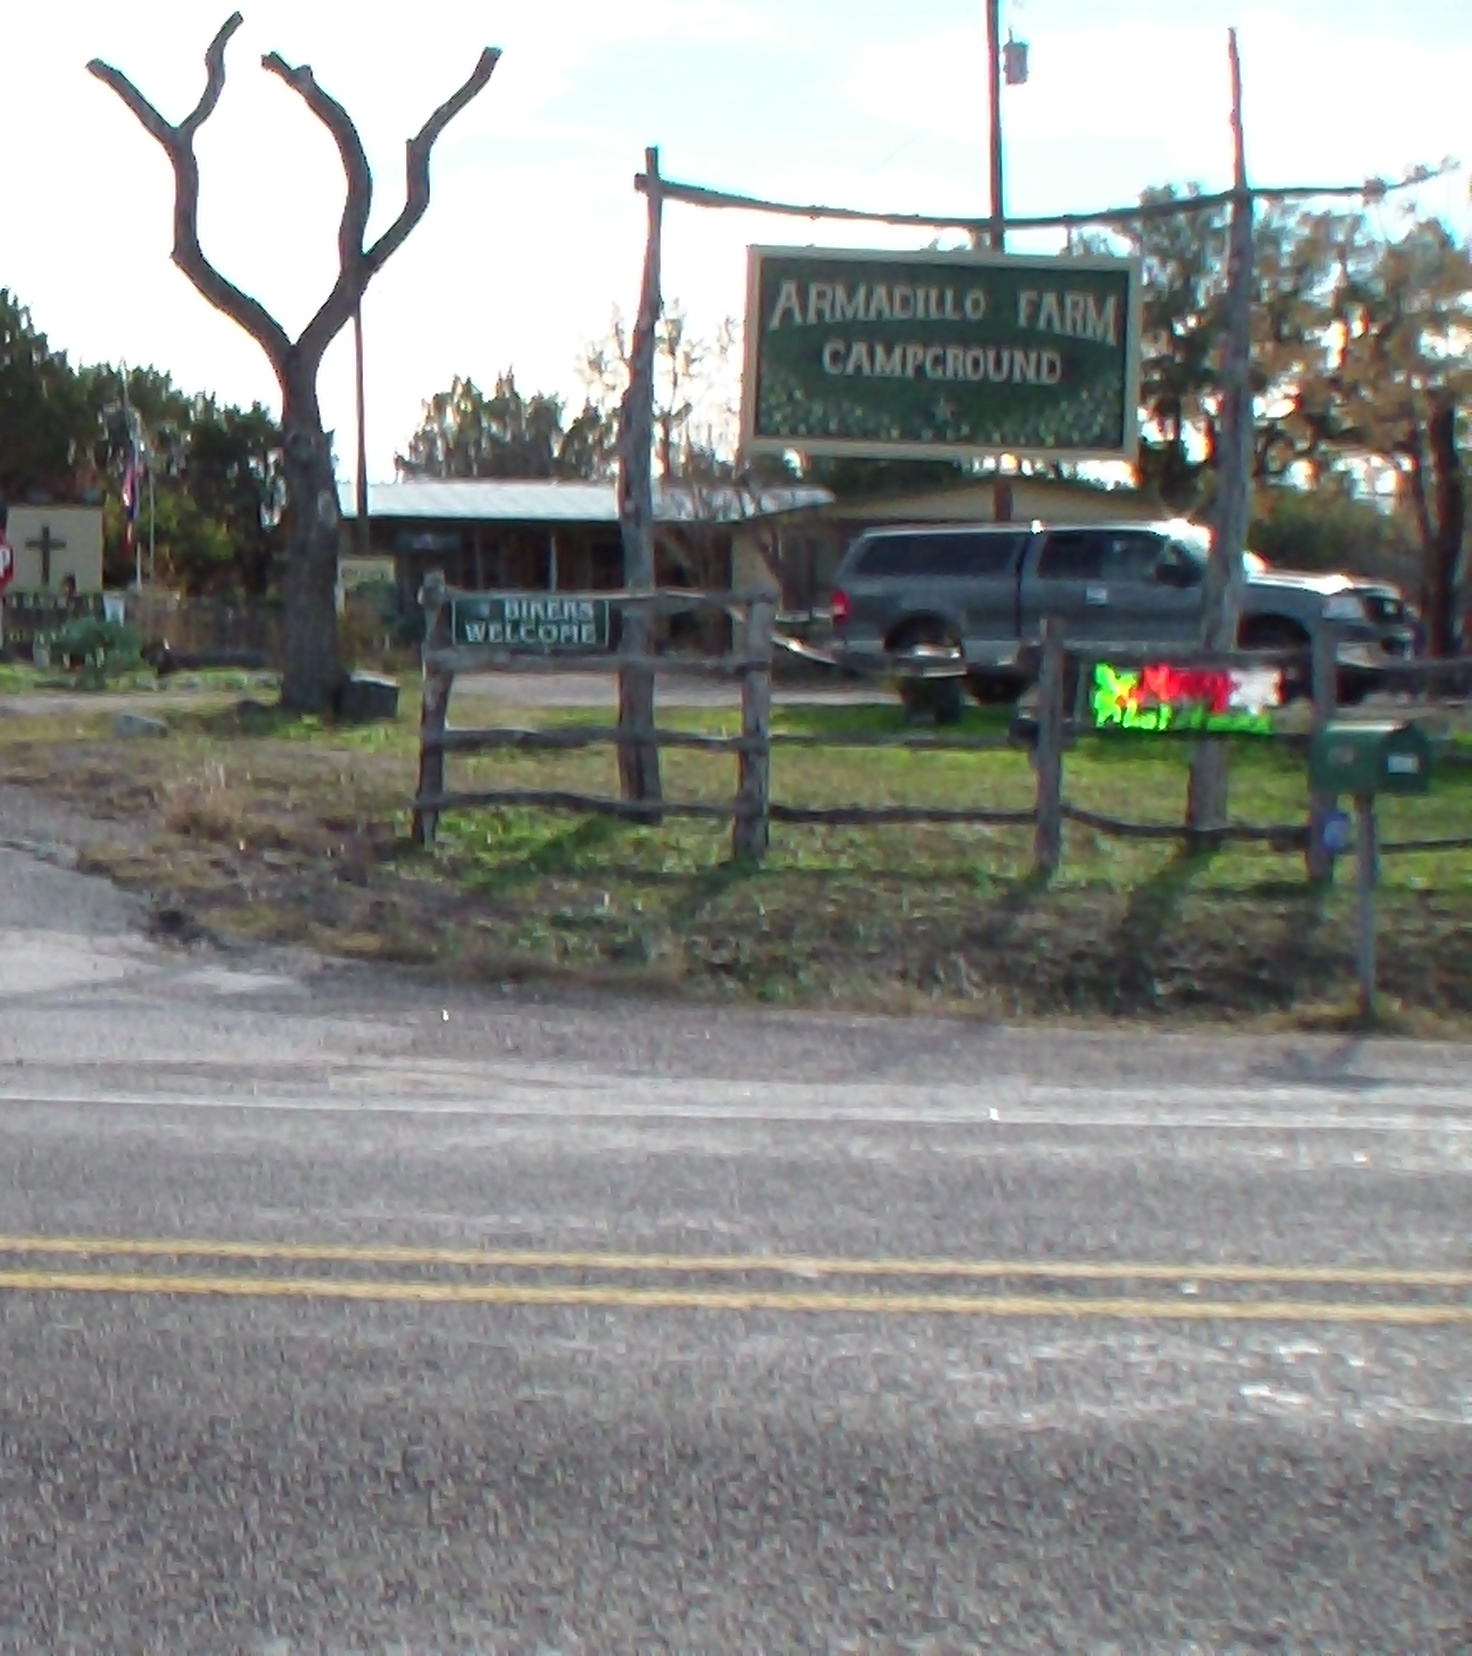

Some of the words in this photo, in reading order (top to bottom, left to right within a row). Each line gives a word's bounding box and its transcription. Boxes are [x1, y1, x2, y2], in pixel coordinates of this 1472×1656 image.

[769, 280, 986, 331] ARMADILLO
[1017, 290, 1117, 346] FARM
[822, 341, 1062, 385] CAMPGROUND
[504, 600, 594, 620] BIKERS
[464, 621, 596, 644] WELCOME
